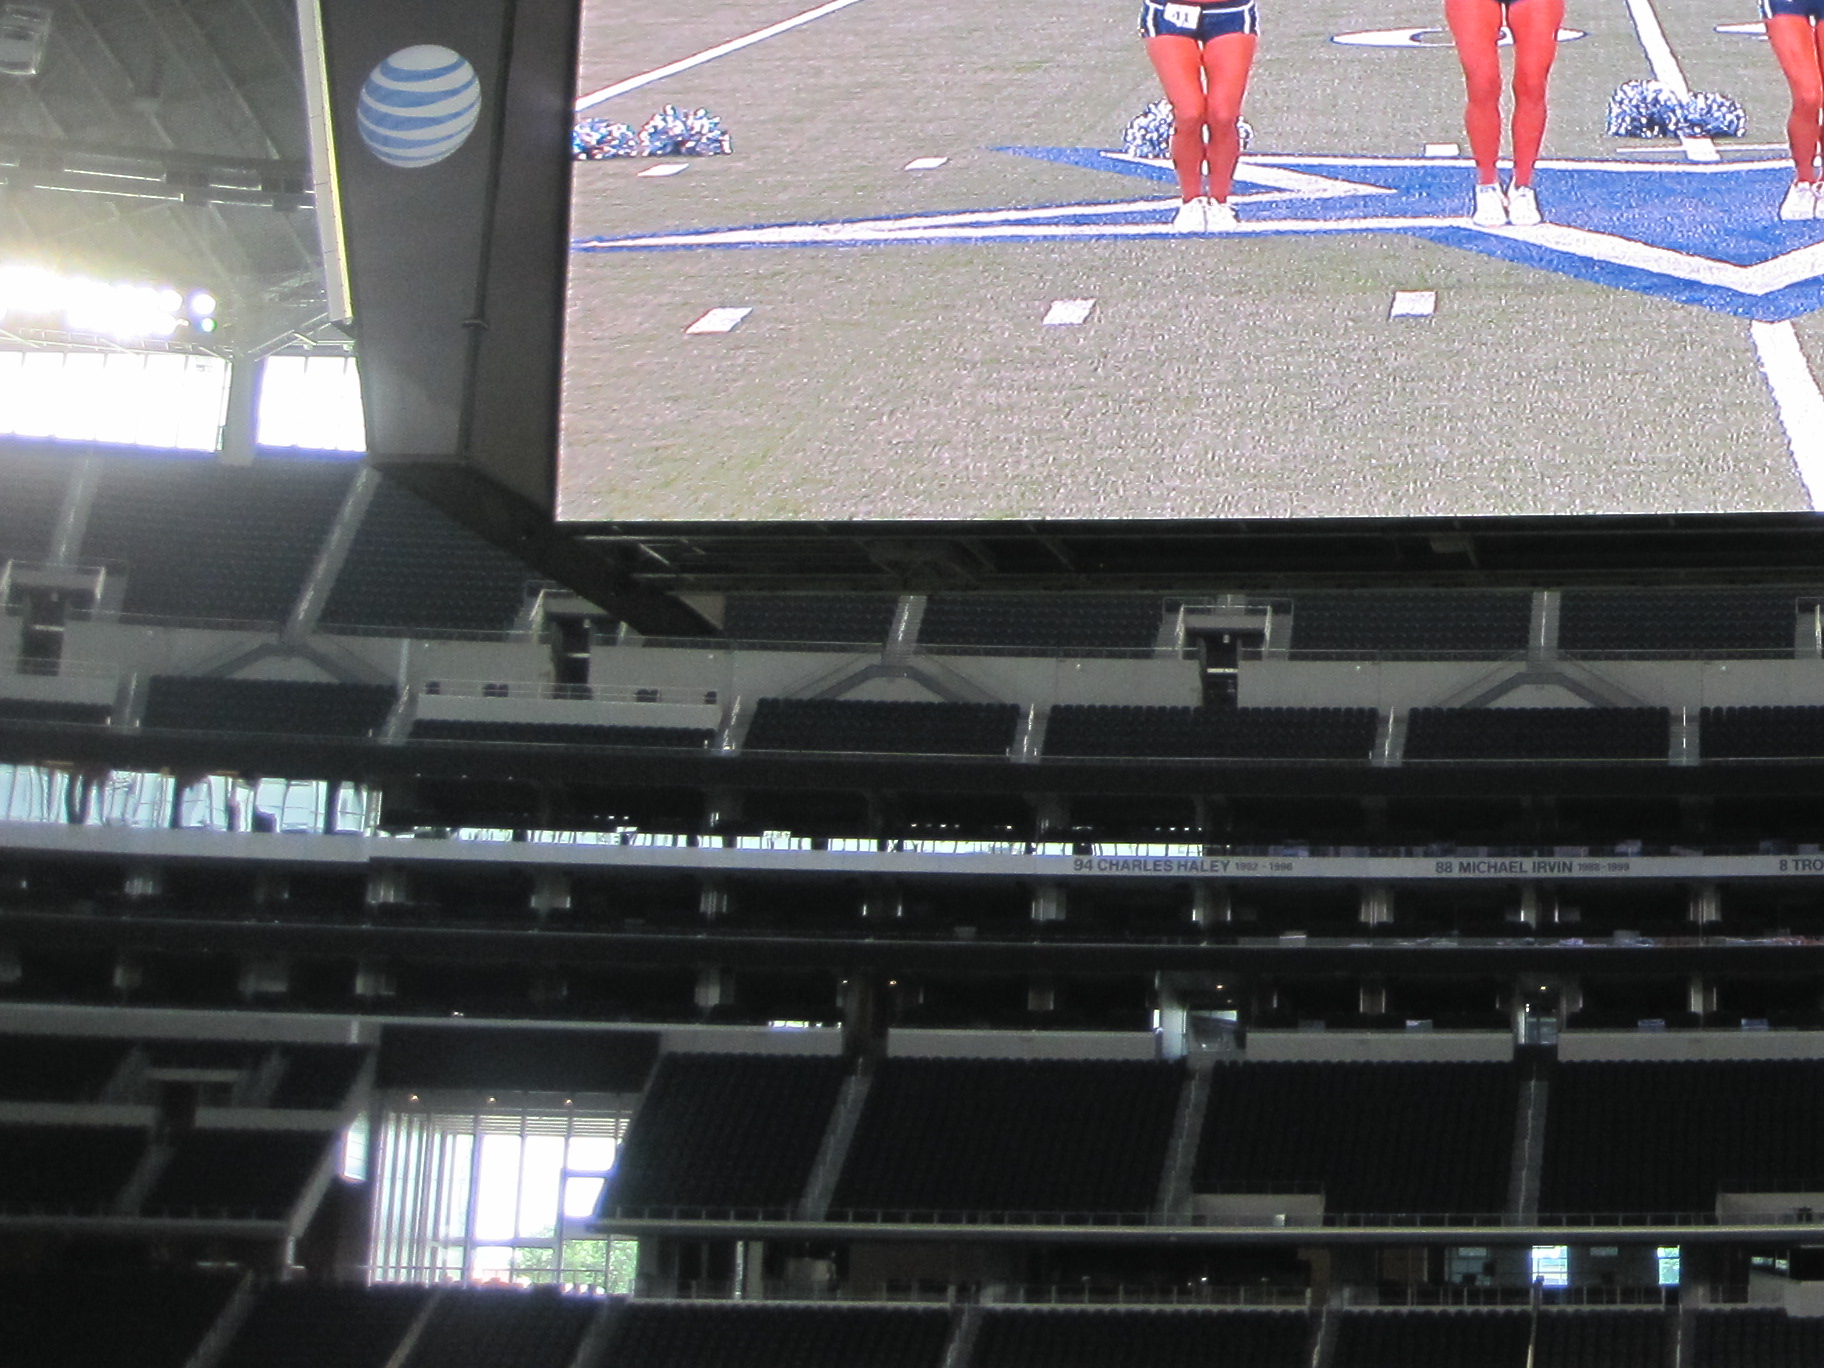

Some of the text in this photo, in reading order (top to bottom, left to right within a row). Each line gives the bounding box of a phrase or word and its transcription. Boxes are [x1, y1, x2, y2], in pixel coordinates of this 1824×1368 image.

[1073, 859, 1093, 872] 94
[1097, 859, 1173, 872] CHARLES
[1177, 859, 1230, 872] HALEY
[1435, 861, 1452, 874] 88
[1458, 861, 1527, 874] MICHAEL
[1532, 861, 1573, 873] IRVIN
[1779, 859, 1788, 871] 8
